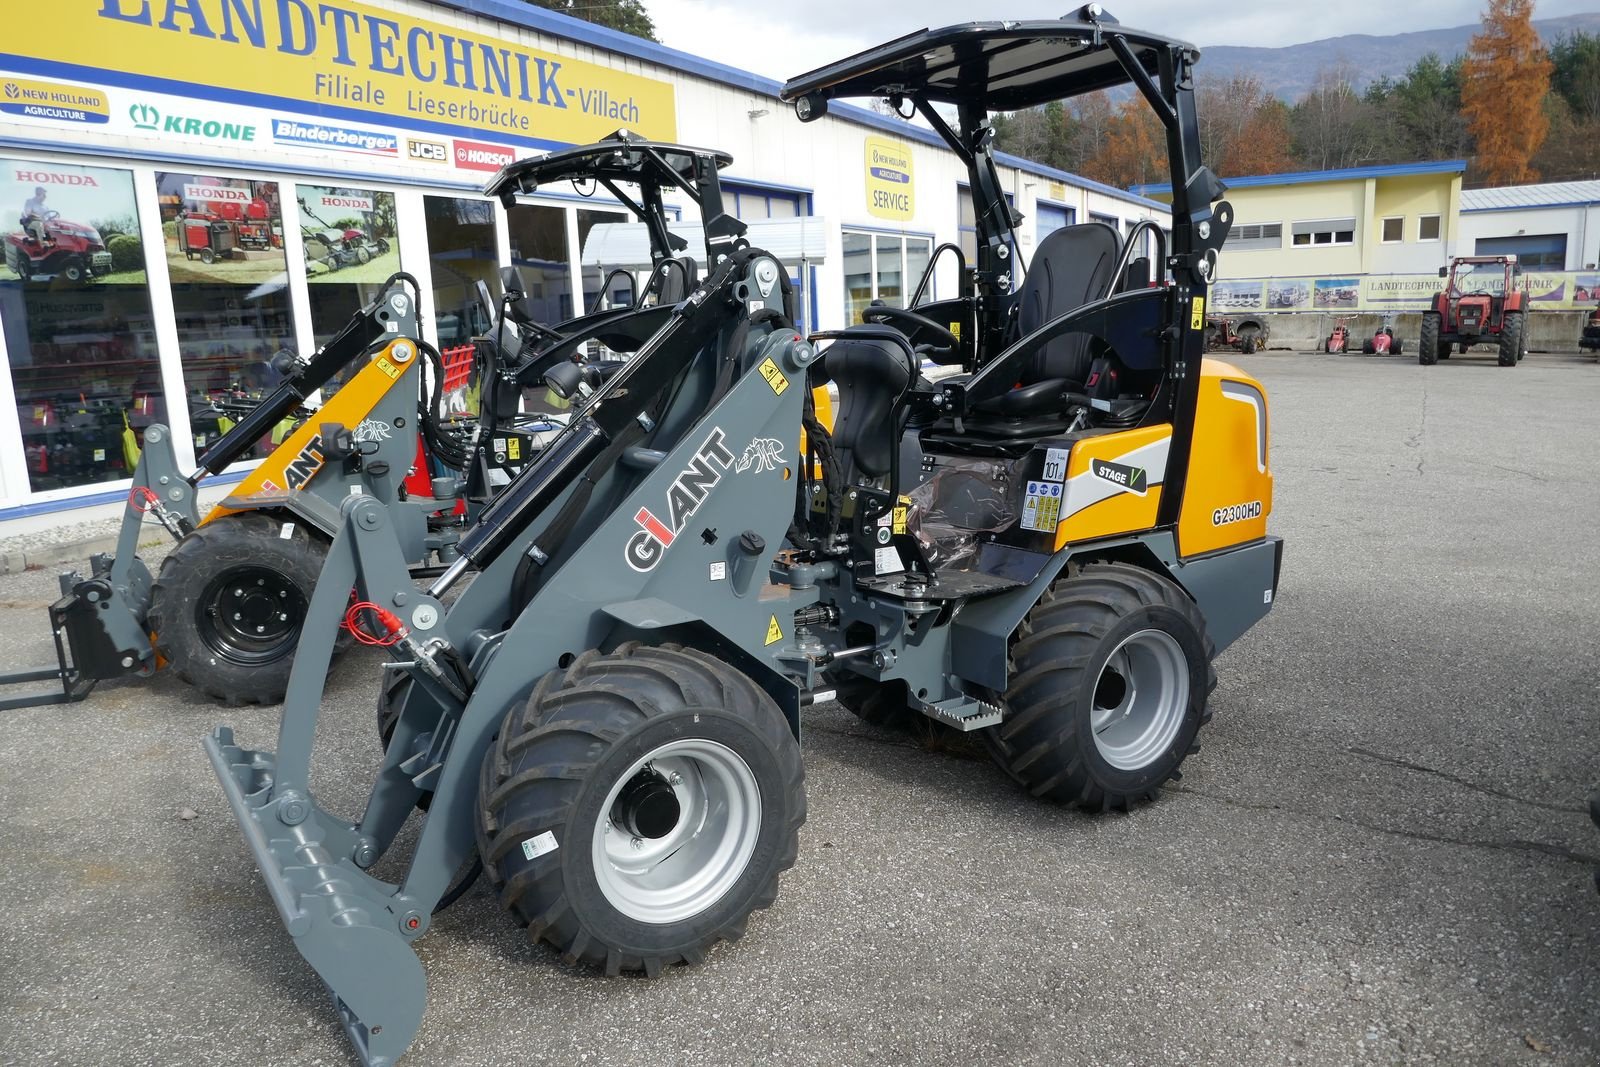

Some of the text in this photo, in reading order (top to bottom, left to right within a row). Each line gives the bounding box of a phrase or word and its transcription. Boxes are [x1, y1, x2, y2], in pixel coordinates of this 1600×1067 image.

[22, 88, 100, 107] NEW HOLLAND
[315, 73, 530, 131] Filiale Lieserbrücke
[24, 106, 86, 120] AGRICULTURE
[164, 115, 257, 142] KRONE
[277, 120, 395, 150] Binderberger
[409, 143, 446, 160] JCB
[467, 149, 513, 166] HORSCH
[15, 170, 99, 187] HONDA
[188, 187, 249, 201] HONDA
[873, 189, 909, 212] SERVICE
[321, 197, 370, 209] HONDA
[1371, 281, 1443, 291] LANDTECHNIK
[1045, 462, 1059, 479] 101
[1099, 466, 1127, 484] STAGE
[1212, 501, 1262, 526] G2300HD
